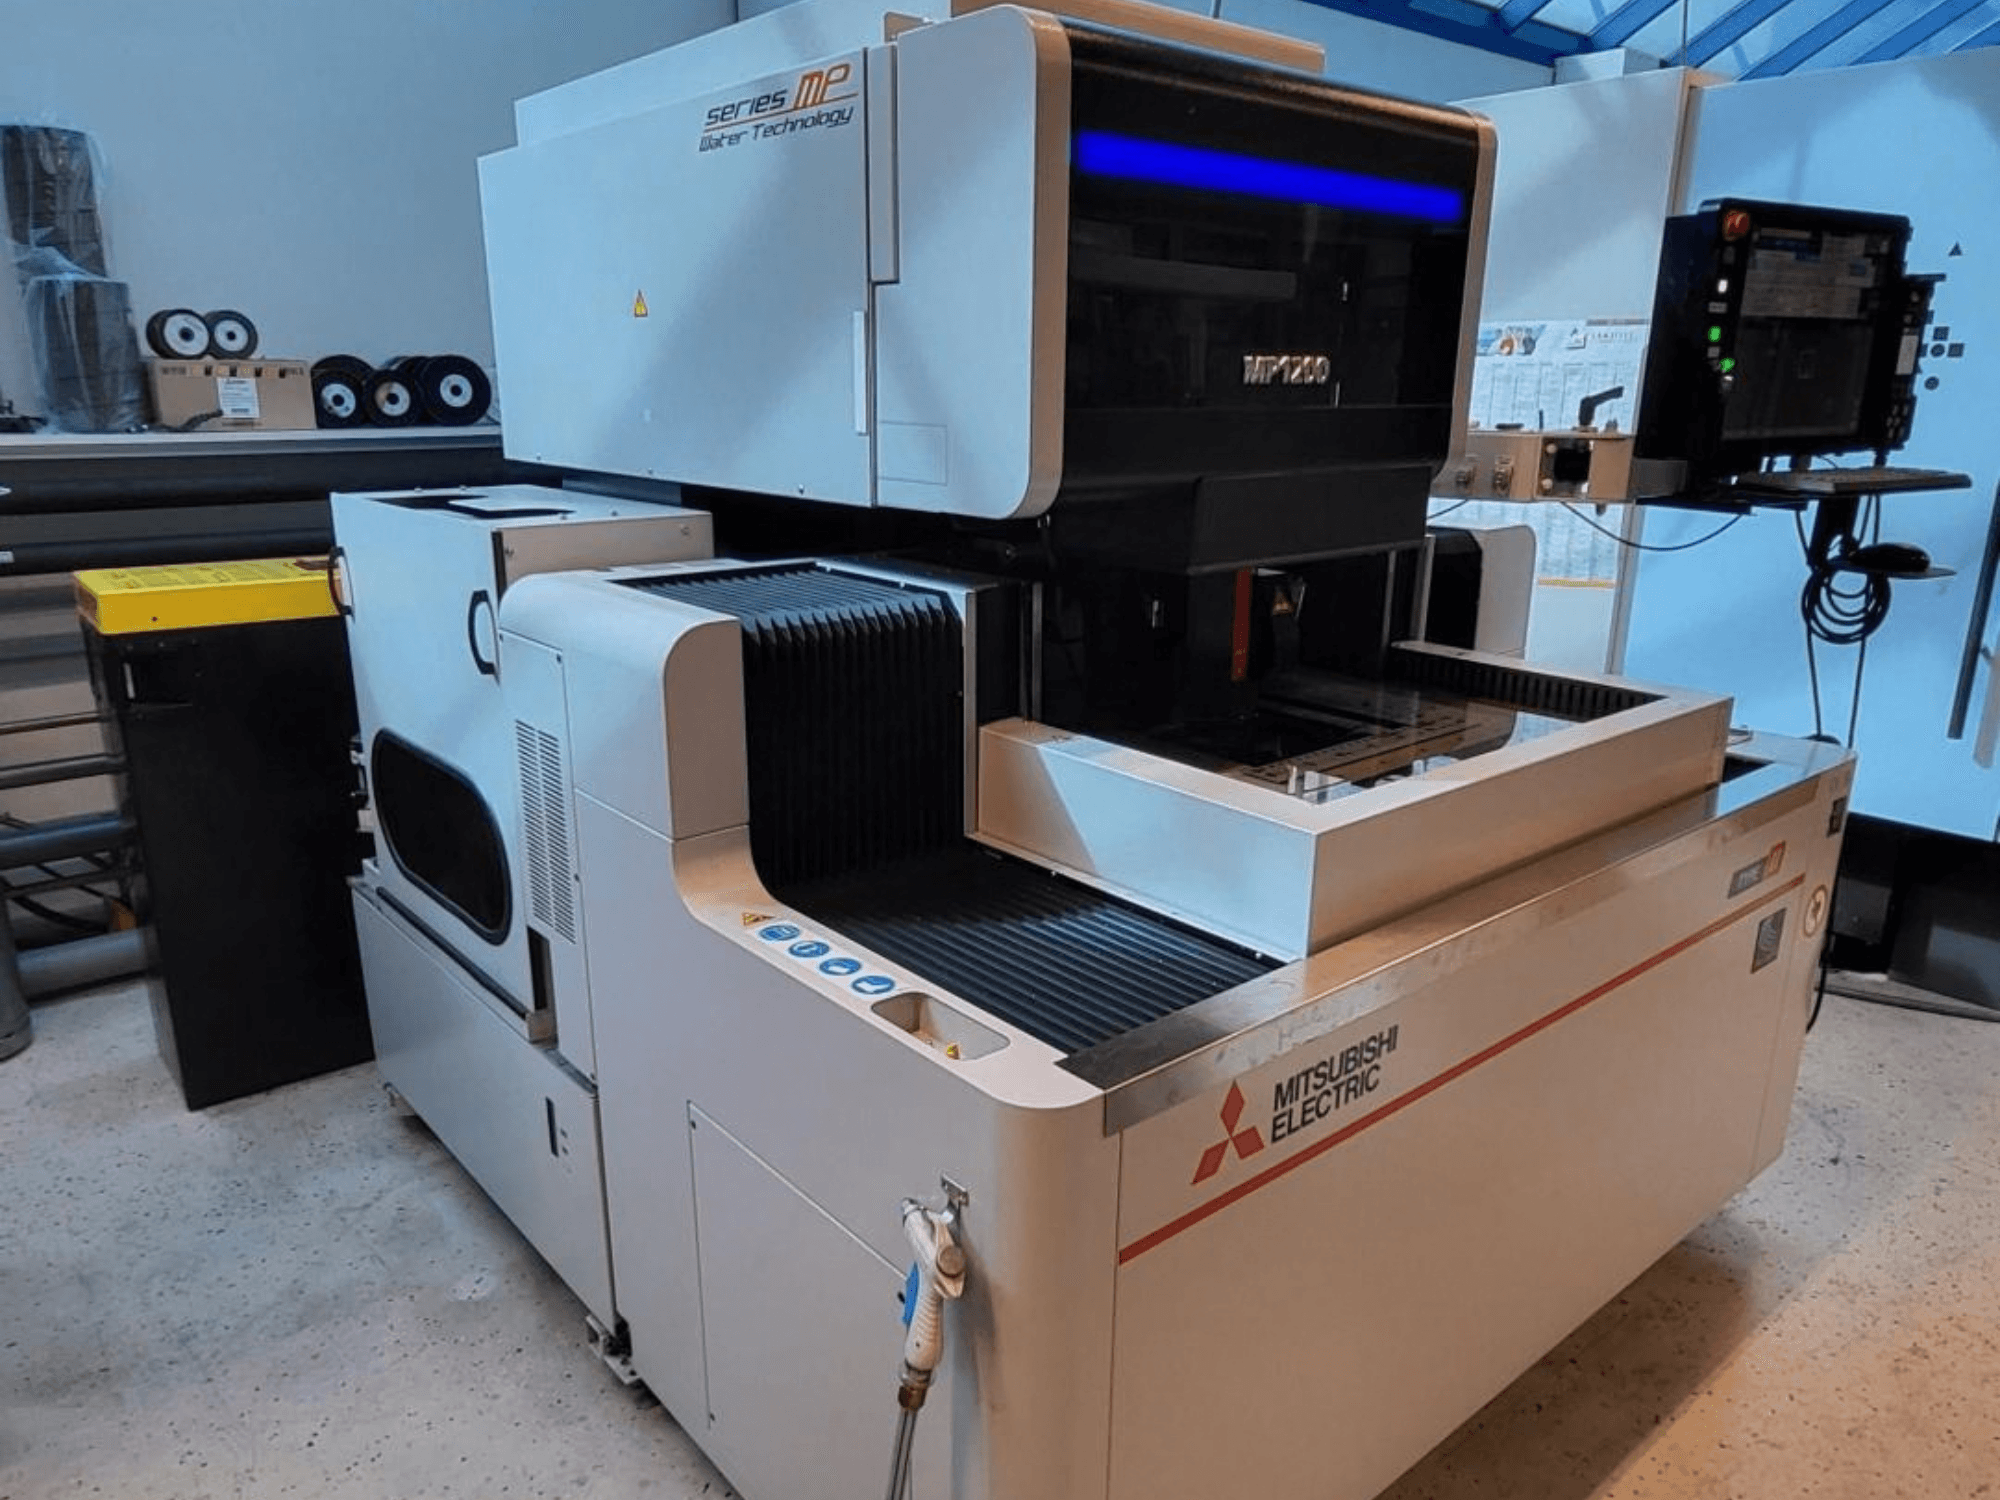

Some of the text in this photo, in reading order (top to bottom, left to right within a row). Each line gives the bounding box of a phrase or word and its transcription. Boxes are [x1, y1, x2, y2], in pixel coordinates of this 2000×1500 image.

[704, 62, 851, 124] series MP
[698, 106, 854, 152] Water Technology
[1270, 1063, 1381, 1144] ELECTRIC
[1273, 1024, 1399, 1112] MITSUBISHI
